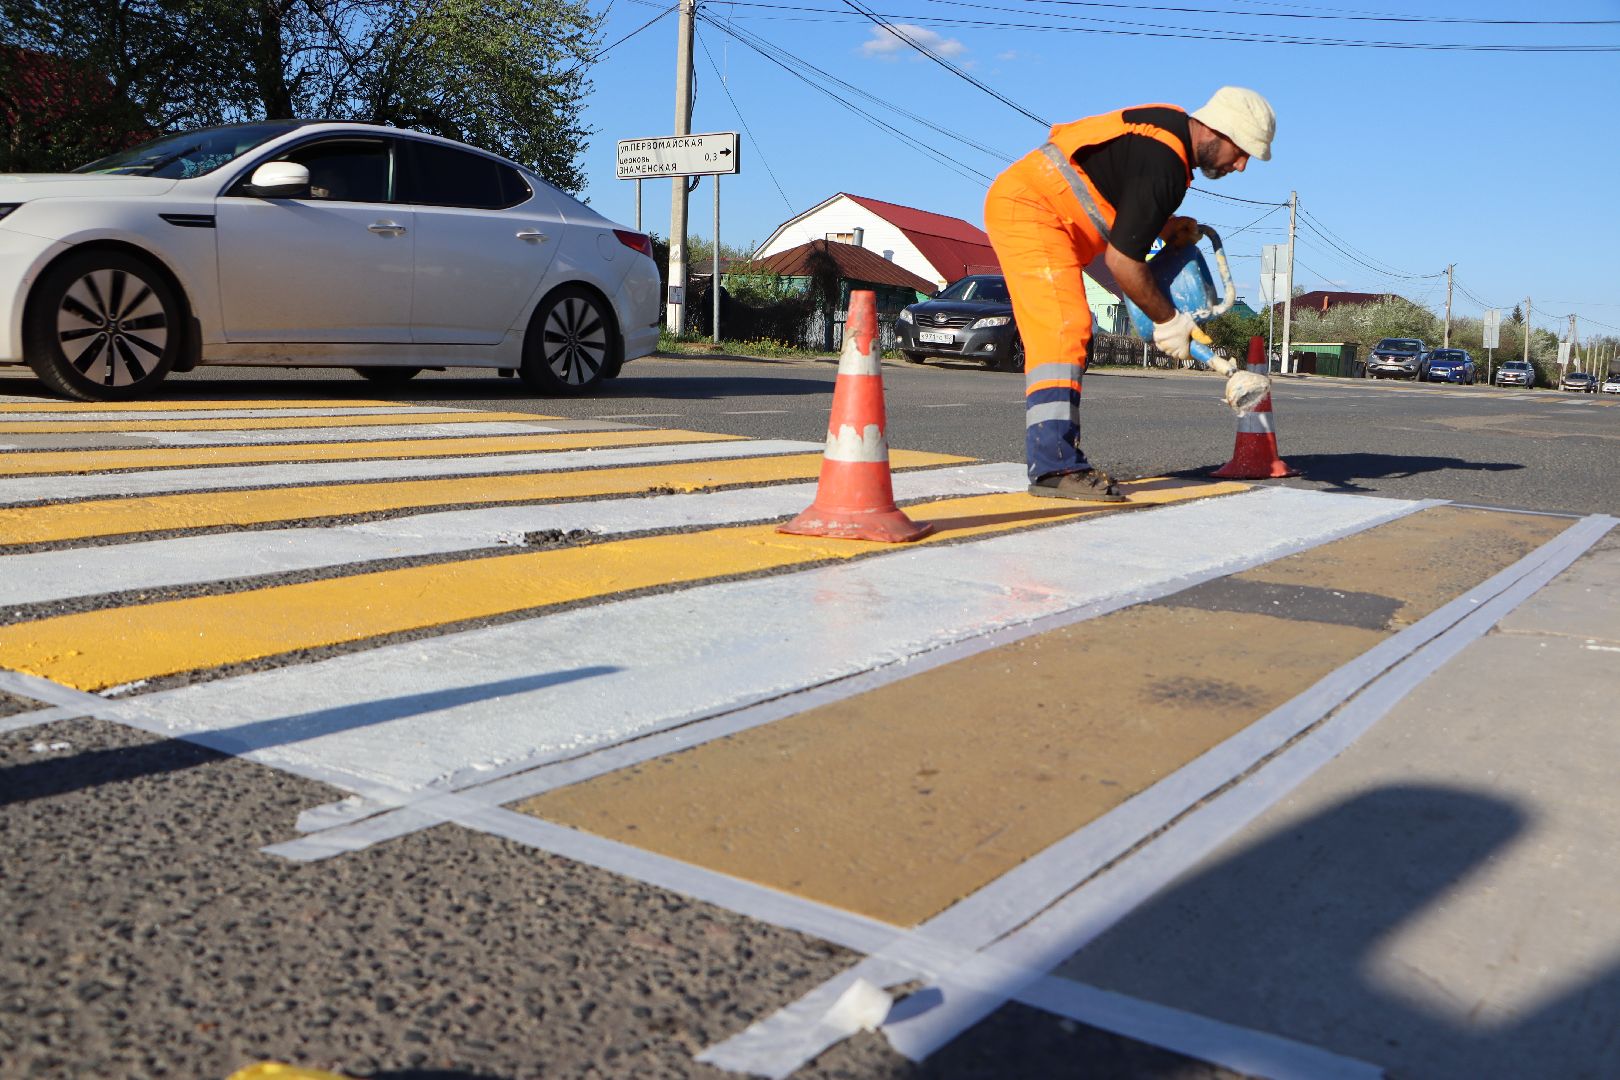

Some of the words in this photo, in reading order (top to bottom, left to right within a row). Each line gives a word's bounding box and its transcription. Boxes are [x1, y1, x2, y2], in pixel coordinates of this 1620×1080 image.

[619, 156, 650, 165] церковь
[704, 153, 718, 162] 0,3
[619, 163, 677, 174] ЗНАМЕНСКАЯ
